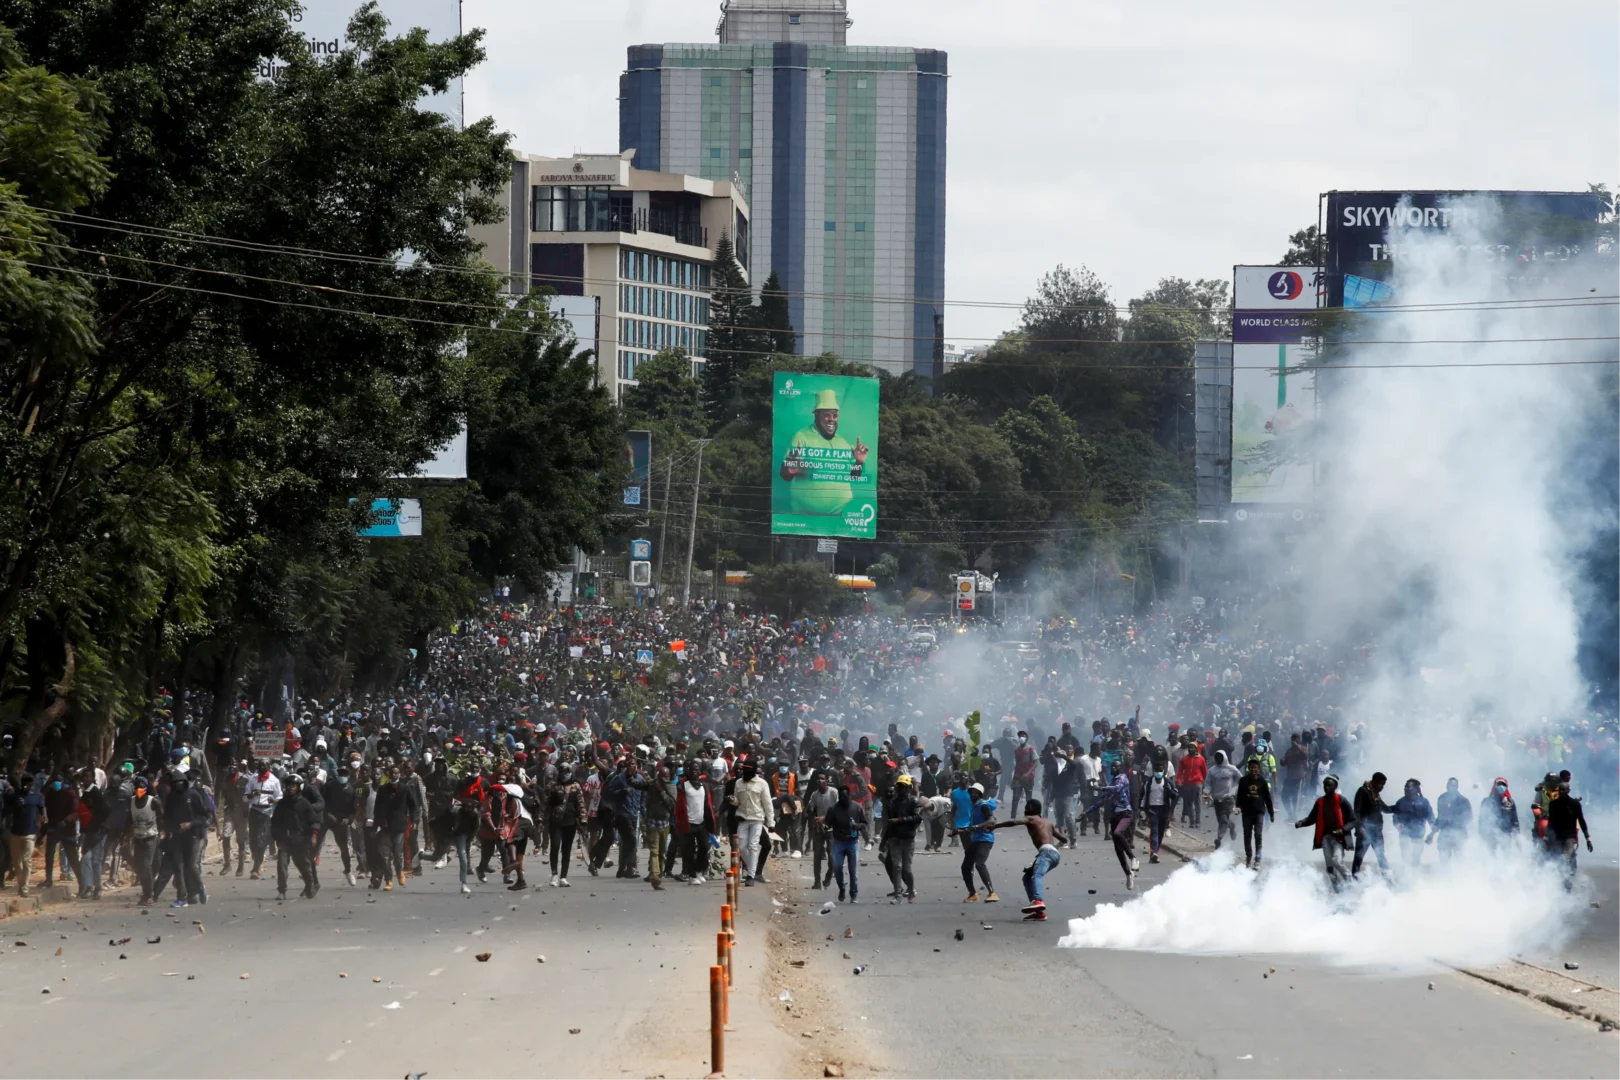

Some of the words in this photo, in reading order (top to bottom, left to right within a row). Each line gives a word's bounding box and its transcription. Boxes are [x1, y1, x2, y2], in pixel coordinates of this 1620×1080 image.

[540, 174, 572, 182] SAROVA
[575, 173, 616, 182] PANAFRIC
[1240, 318, 1271, 327] WORLD
[1273, 318, 1300, 327] CLASS
[792, 448, 806, 456] I'VE
[808, 448, 824, 457] GOT
[833, 450, 852, 459] PLAN
[800, 461, 823, 469] GROWS
[844, 518, 864, 527] YOUR
